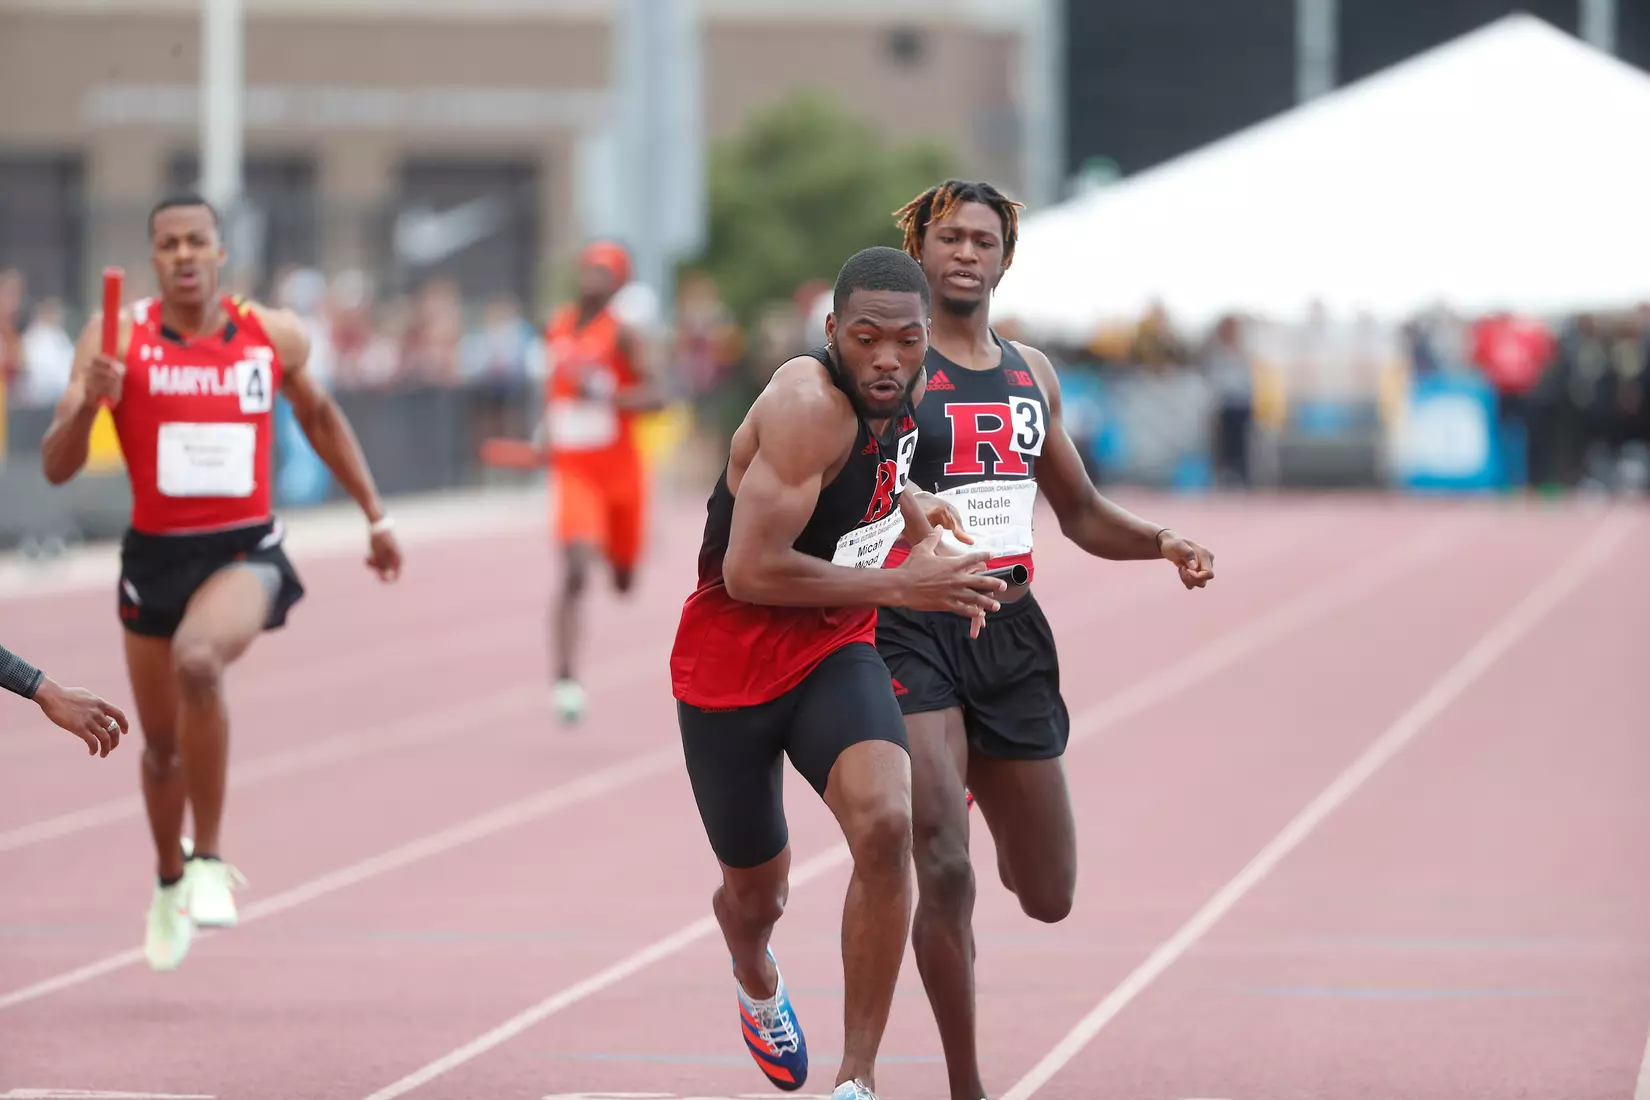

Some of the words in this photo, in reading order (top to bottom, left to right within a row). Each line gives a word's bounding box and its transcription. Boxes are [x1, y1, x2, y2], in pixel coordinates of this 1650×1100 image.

[246, 367, 265, 403] 4
[1016, 401, 1041, 450] 3
[944, 402, 1029, 476] R
[966, 496, 1012, 511] Nadale
[968, 513, 1011, 528] Buntin
[857, 538, 884, 558] Micah
[854, 552, 880, 569] Wood
